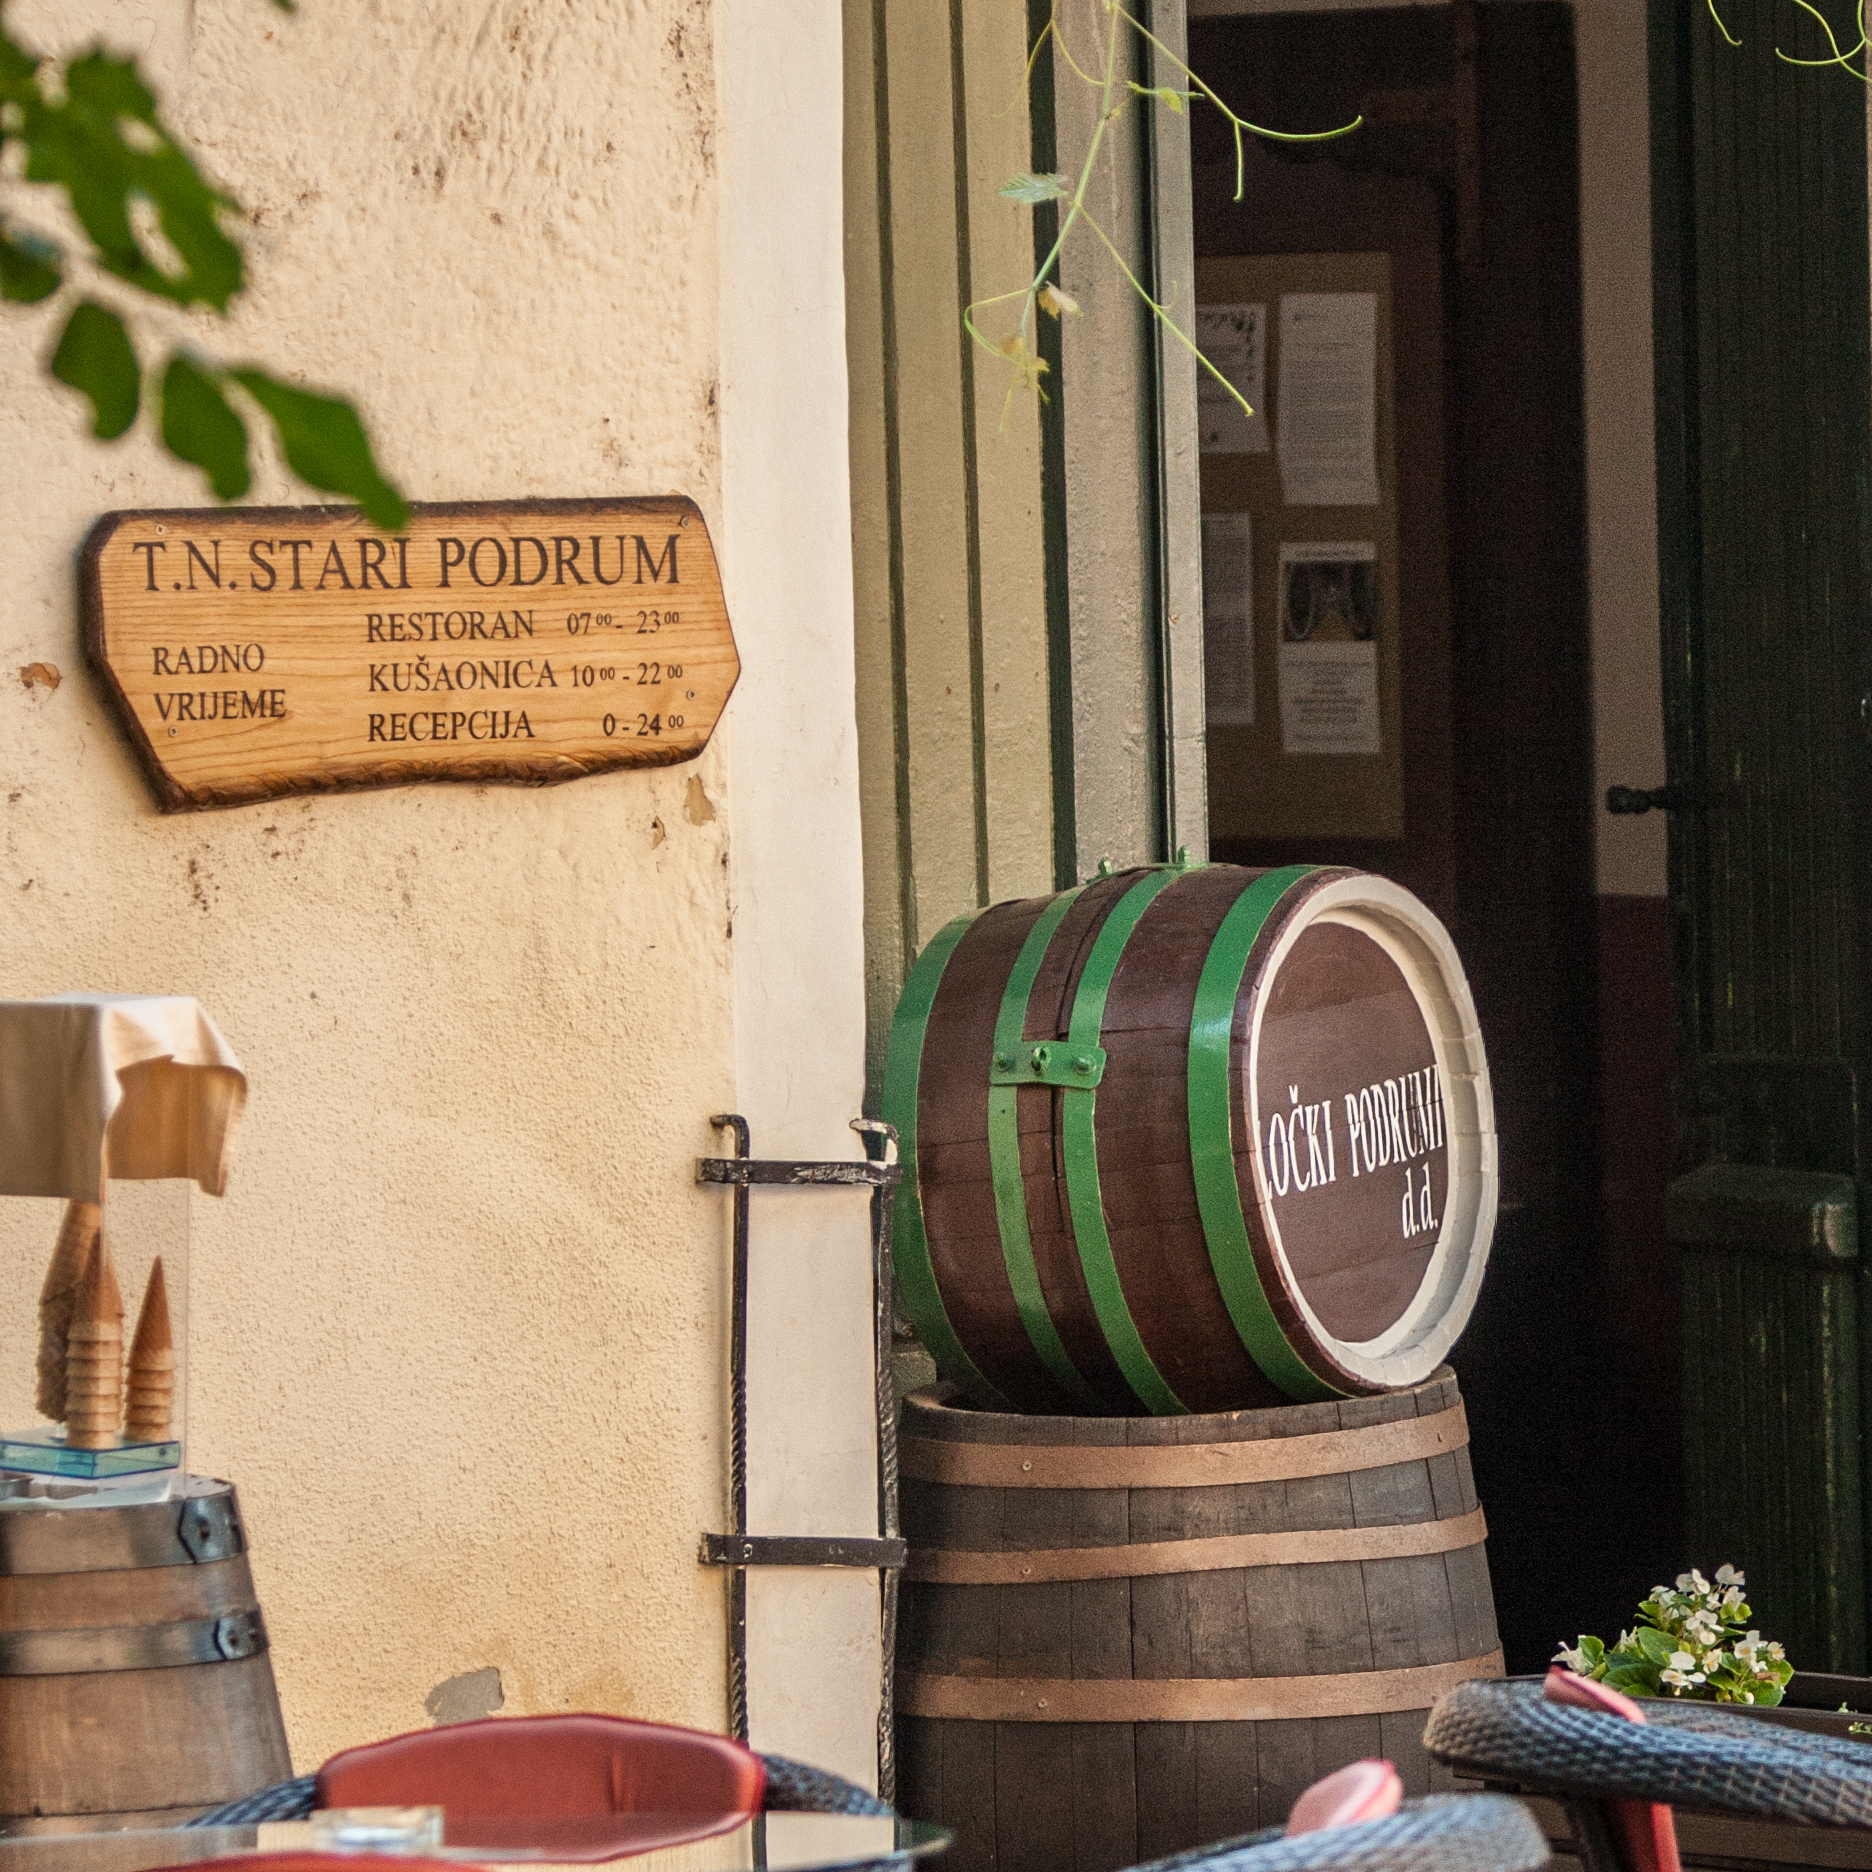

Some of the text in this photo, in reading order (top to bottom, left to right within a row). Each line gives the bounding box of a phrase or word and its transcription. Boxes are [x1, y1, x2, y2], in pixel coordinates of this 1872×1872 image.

[437, 533, 681, 588] PODRUM
[366, 610, 534, 643] RESTORAN
[152, 643, 265, 676] RADNO
[368, 654, 558, 692] KUŠAONICA
[154, 688, 287, 721] VRIJEME
[368, 710, 536, 742] RECEPCIJA
[1401, 1160, 1439, 1239] d.d.
